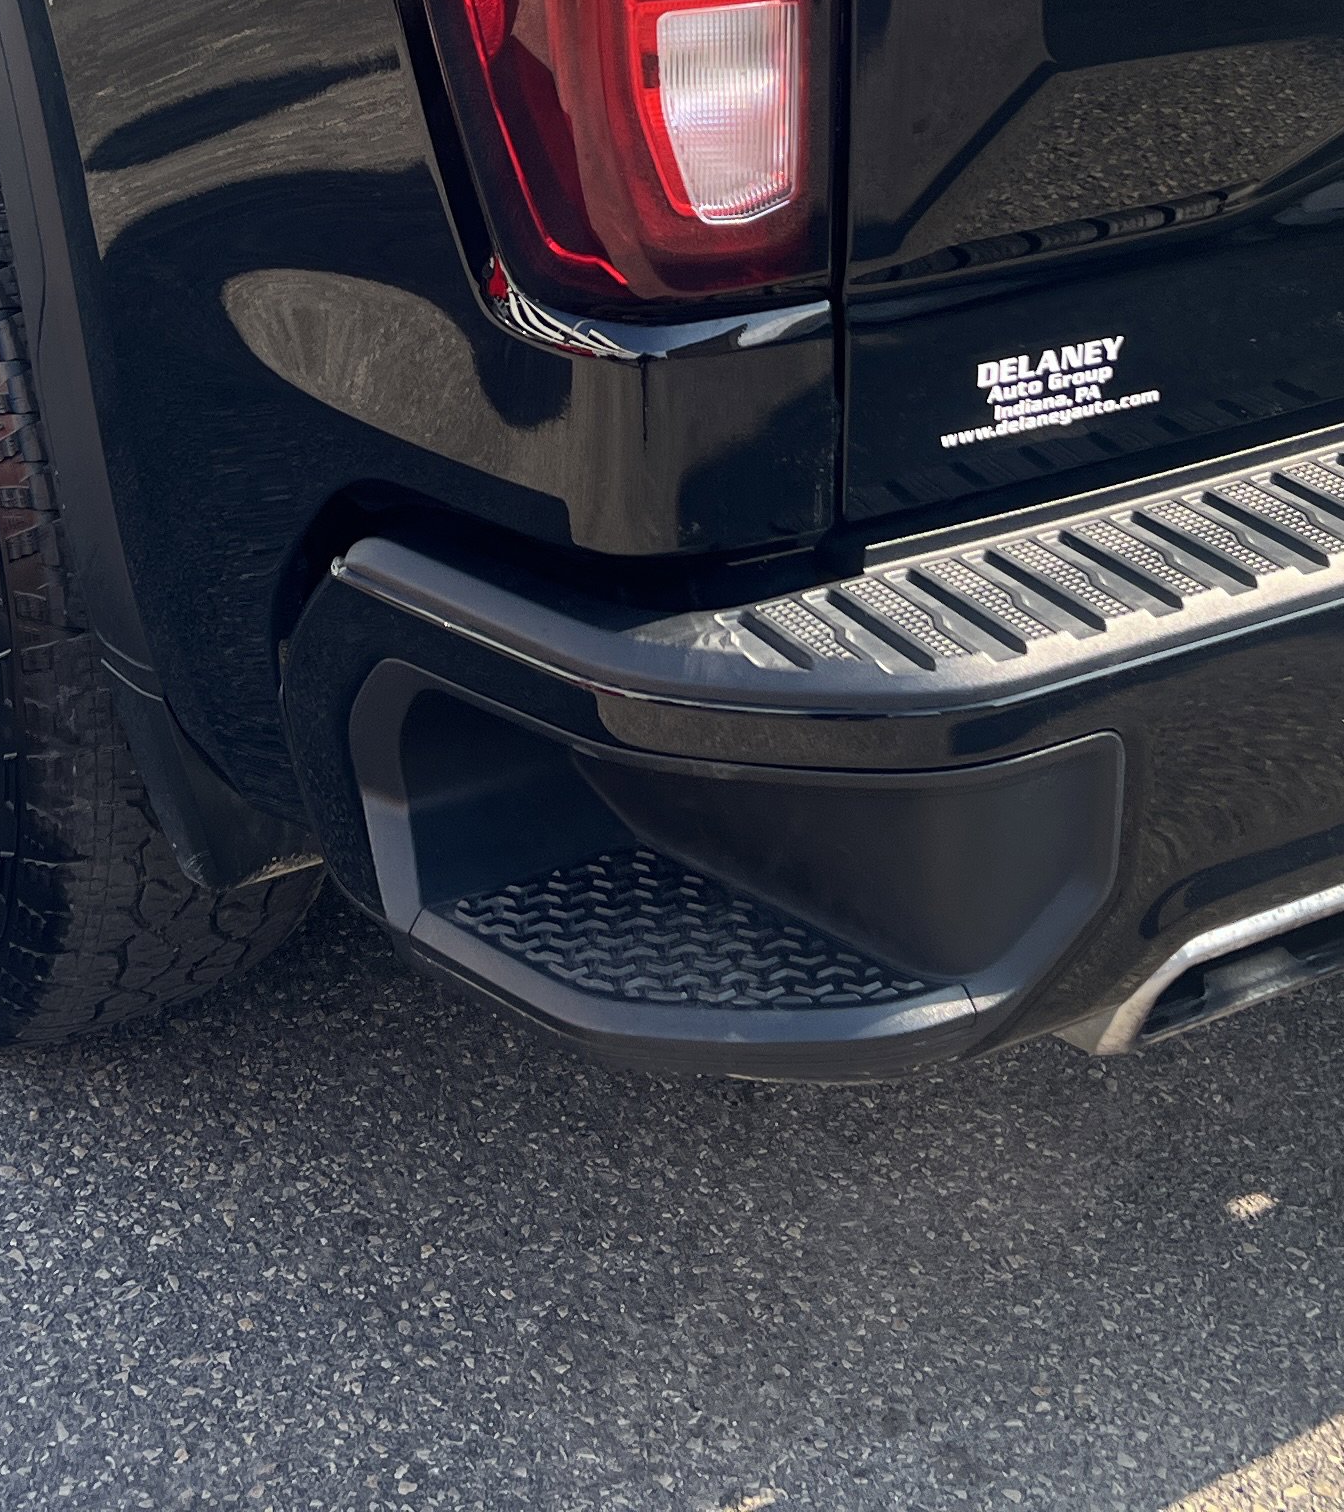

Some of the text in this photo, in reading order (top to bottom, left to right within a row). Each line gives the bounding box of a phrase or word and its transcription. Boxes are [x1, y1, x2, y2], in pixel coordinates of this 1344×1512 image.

[976, 335, 1125, 389] DELANEY
[987, 365, 1114, 405] Auto Group
[1074, 384, 1102, 405] PA
[940, 389, 1161, 449] www.delaneyauto.com
